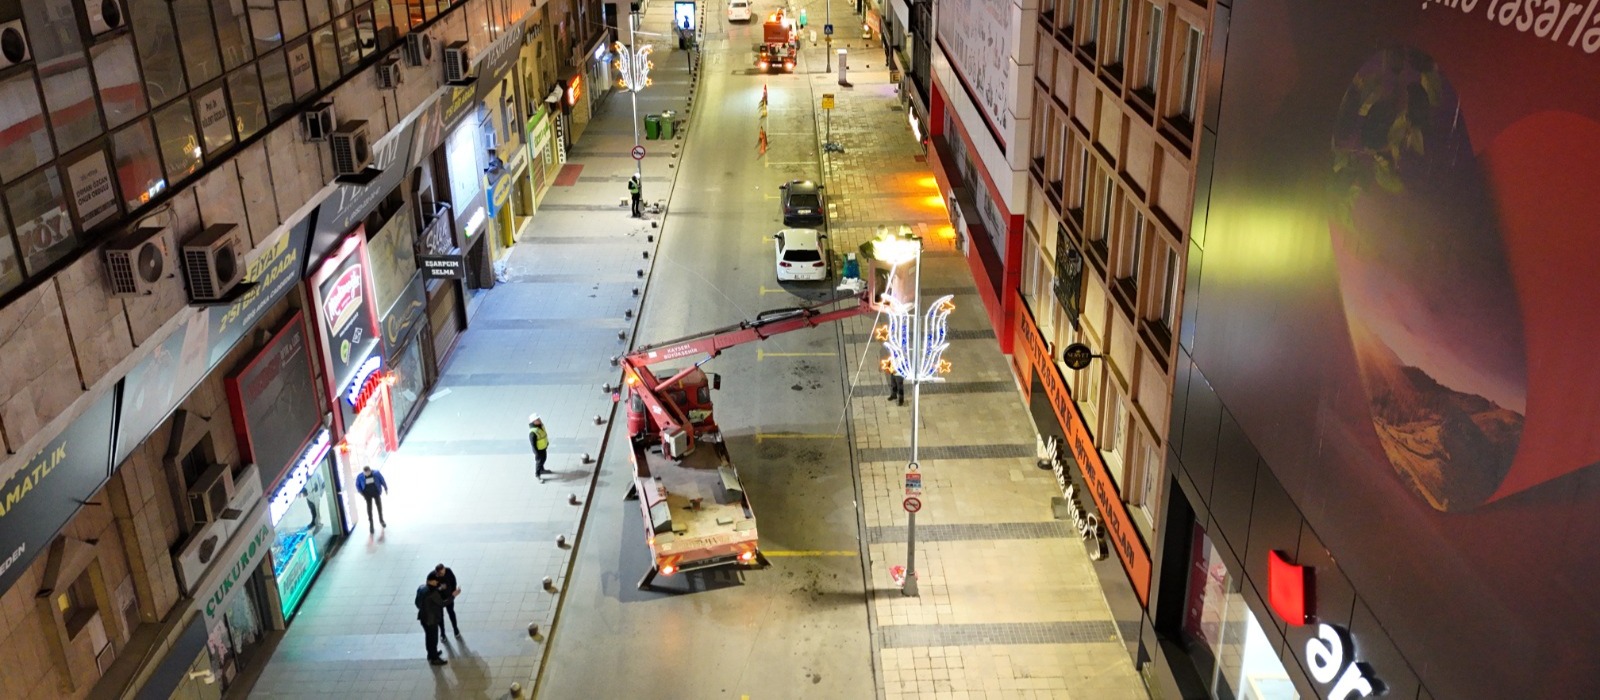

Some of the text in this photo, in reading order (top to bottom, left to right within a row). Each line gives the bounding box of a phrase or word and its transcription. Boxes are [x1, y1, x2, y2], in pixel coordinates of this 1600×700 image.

[262, 247, 297, 291] ARADA
[431, 268, 455, 276] SELMA
[1020, 309, 1073, 437] ERCİYESPARK
[1046, 434, 1088, 542] White Angel
[205, 524, 269, 619] ÇUKUROVA
